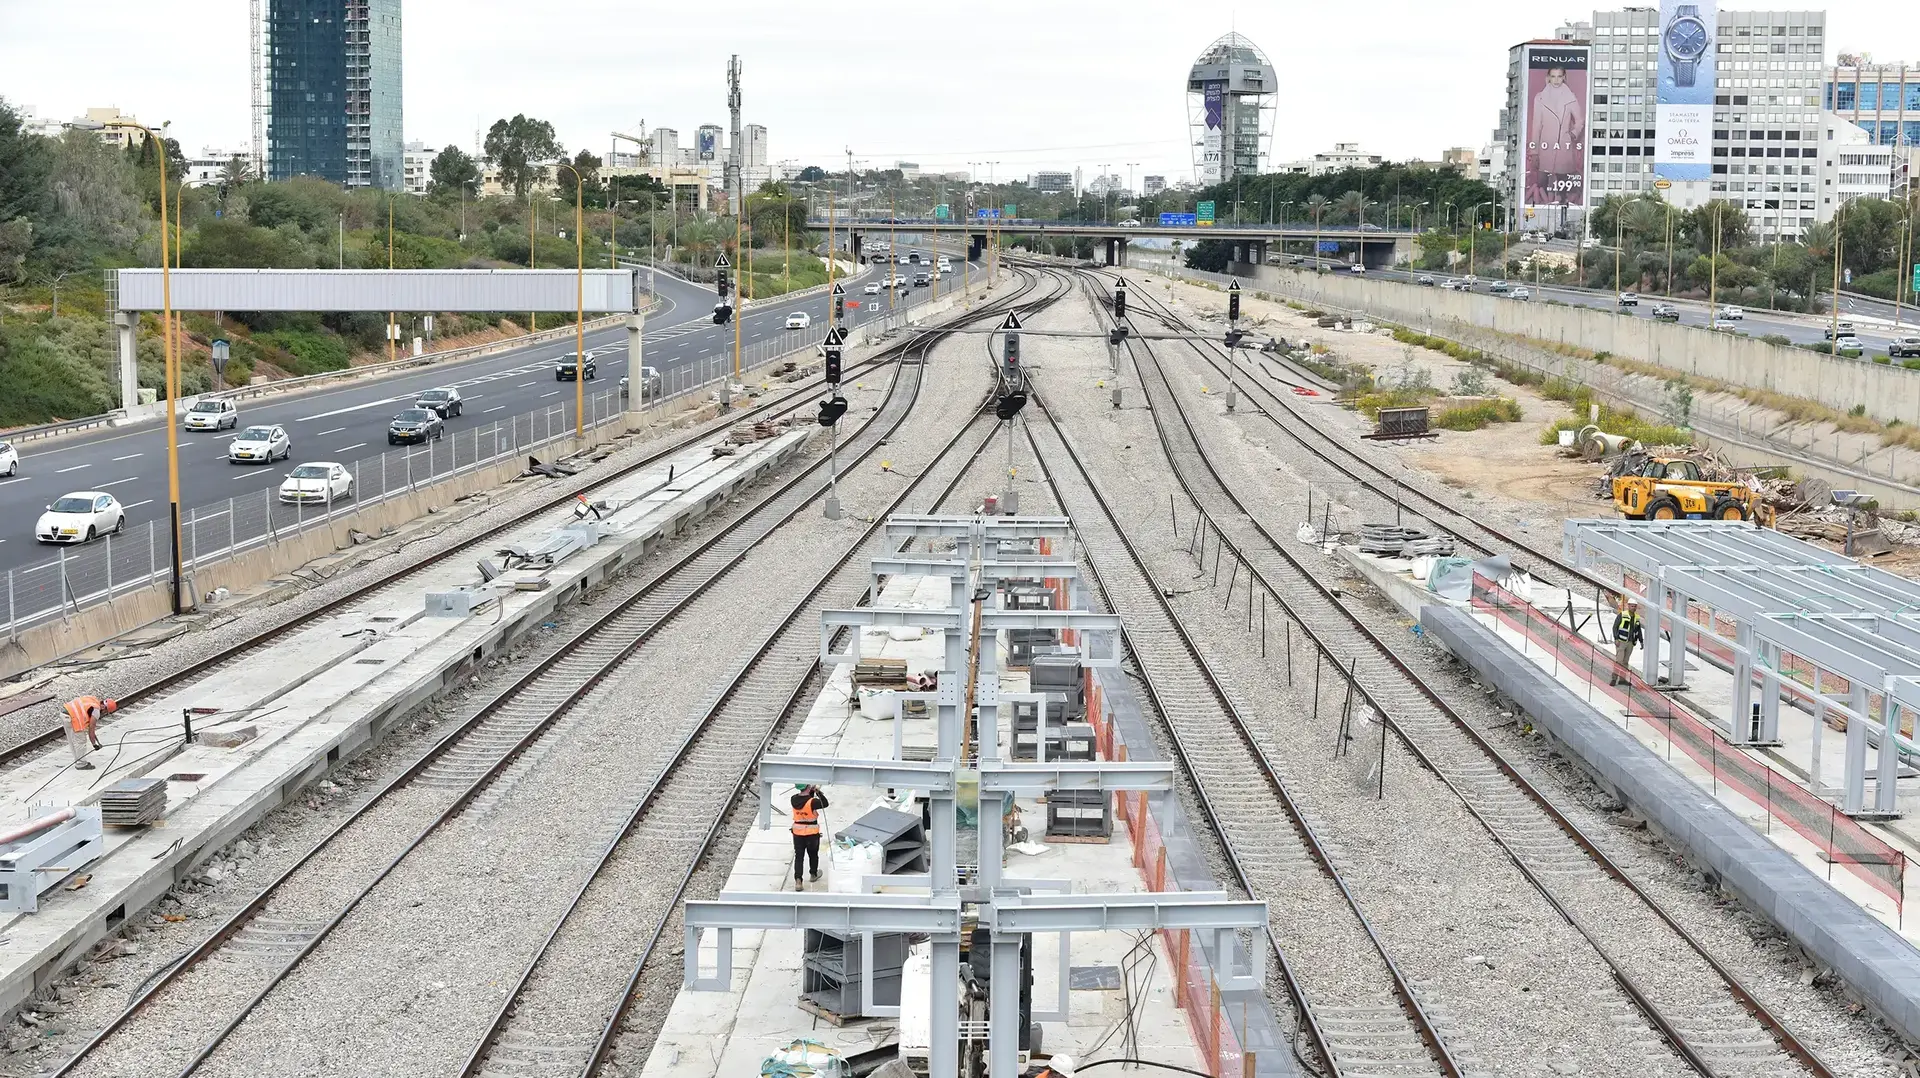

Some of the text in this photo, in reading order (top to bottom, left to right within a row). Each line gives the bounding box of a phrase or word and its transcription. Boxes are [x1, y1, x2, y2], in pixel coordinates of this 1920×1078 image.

[1529, 142, 1582, 150] COATS
[1009, 316, 1015, 328] 4
[830, 332, 836, 344] 4
